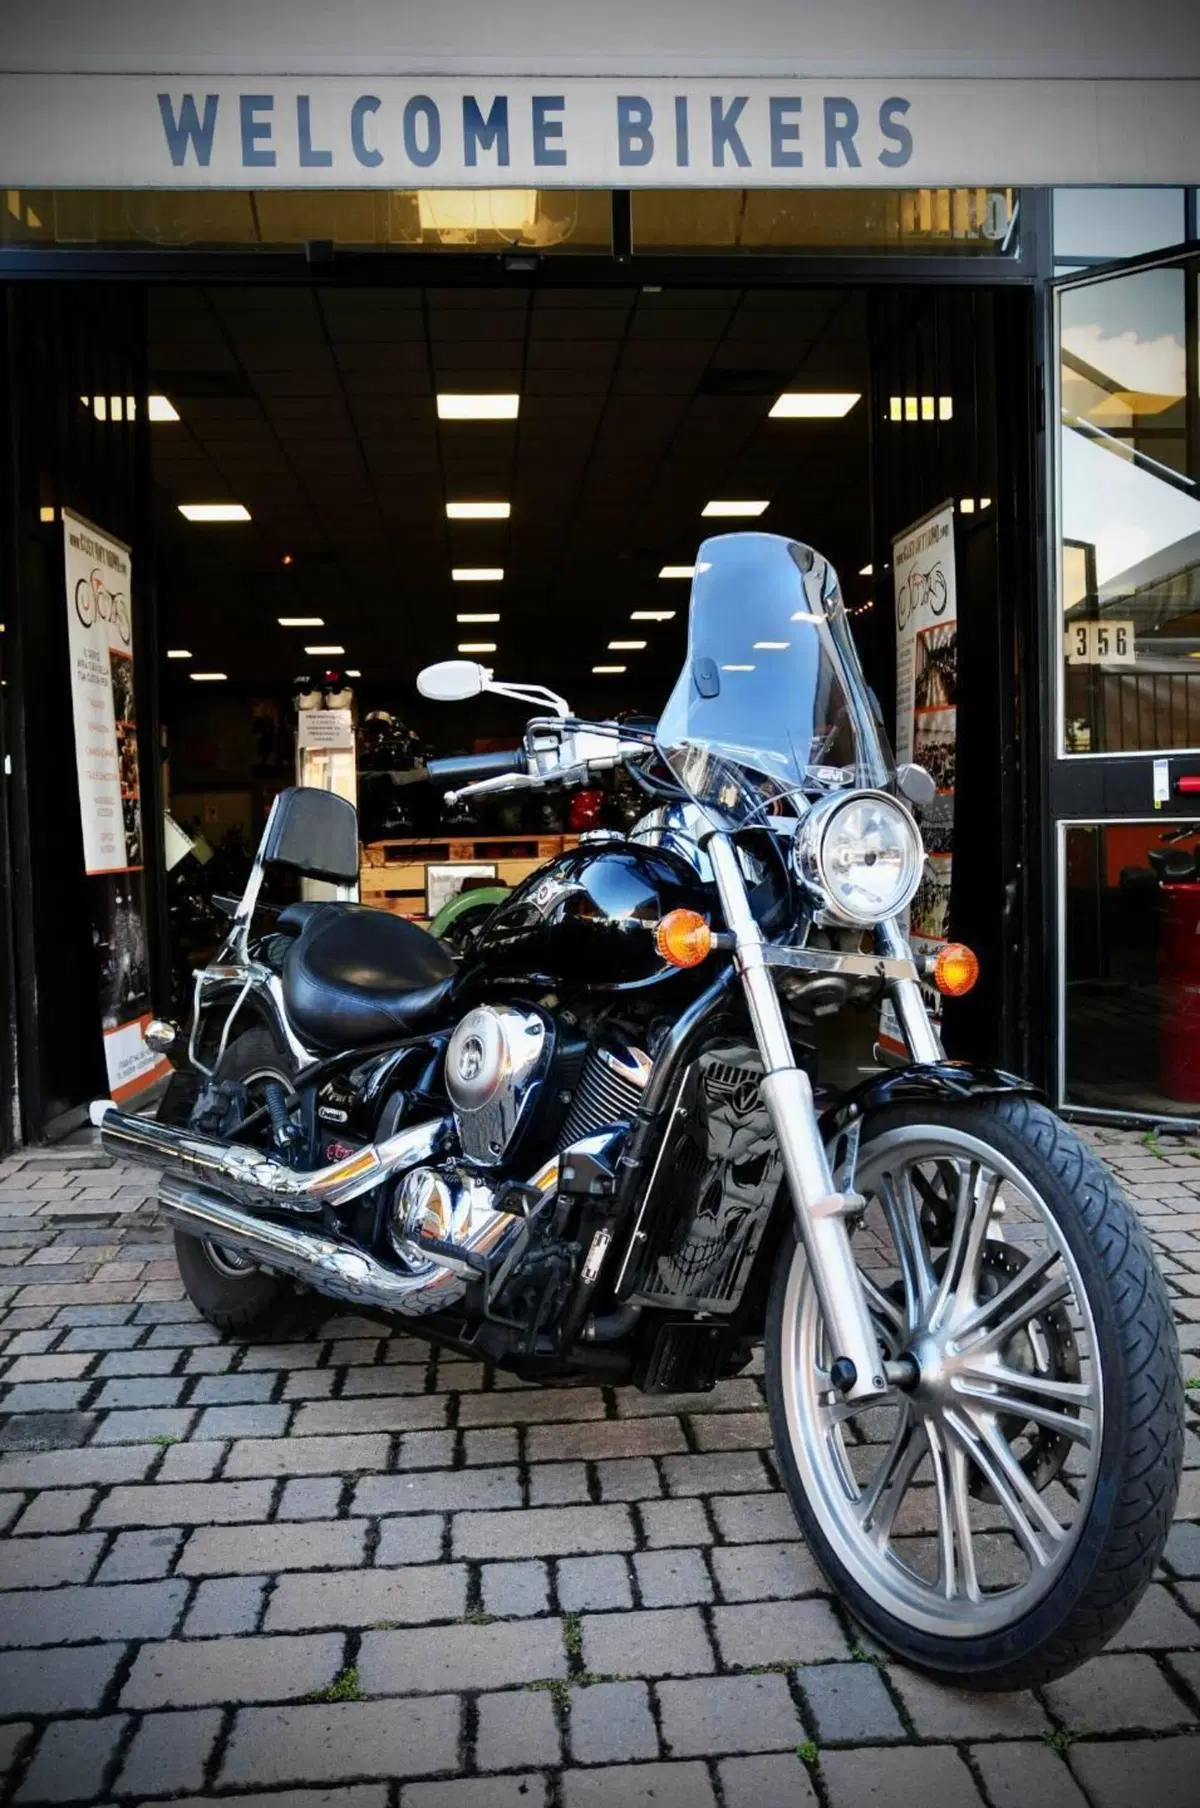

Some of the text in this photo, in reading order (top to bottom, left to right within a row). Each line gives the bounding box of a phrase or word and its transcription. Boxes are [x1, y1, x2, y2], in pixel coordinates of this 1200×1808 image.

[156, 93, 914, 169] WELCOME BIKERS
[1076, 627, 1127, 656] 356
